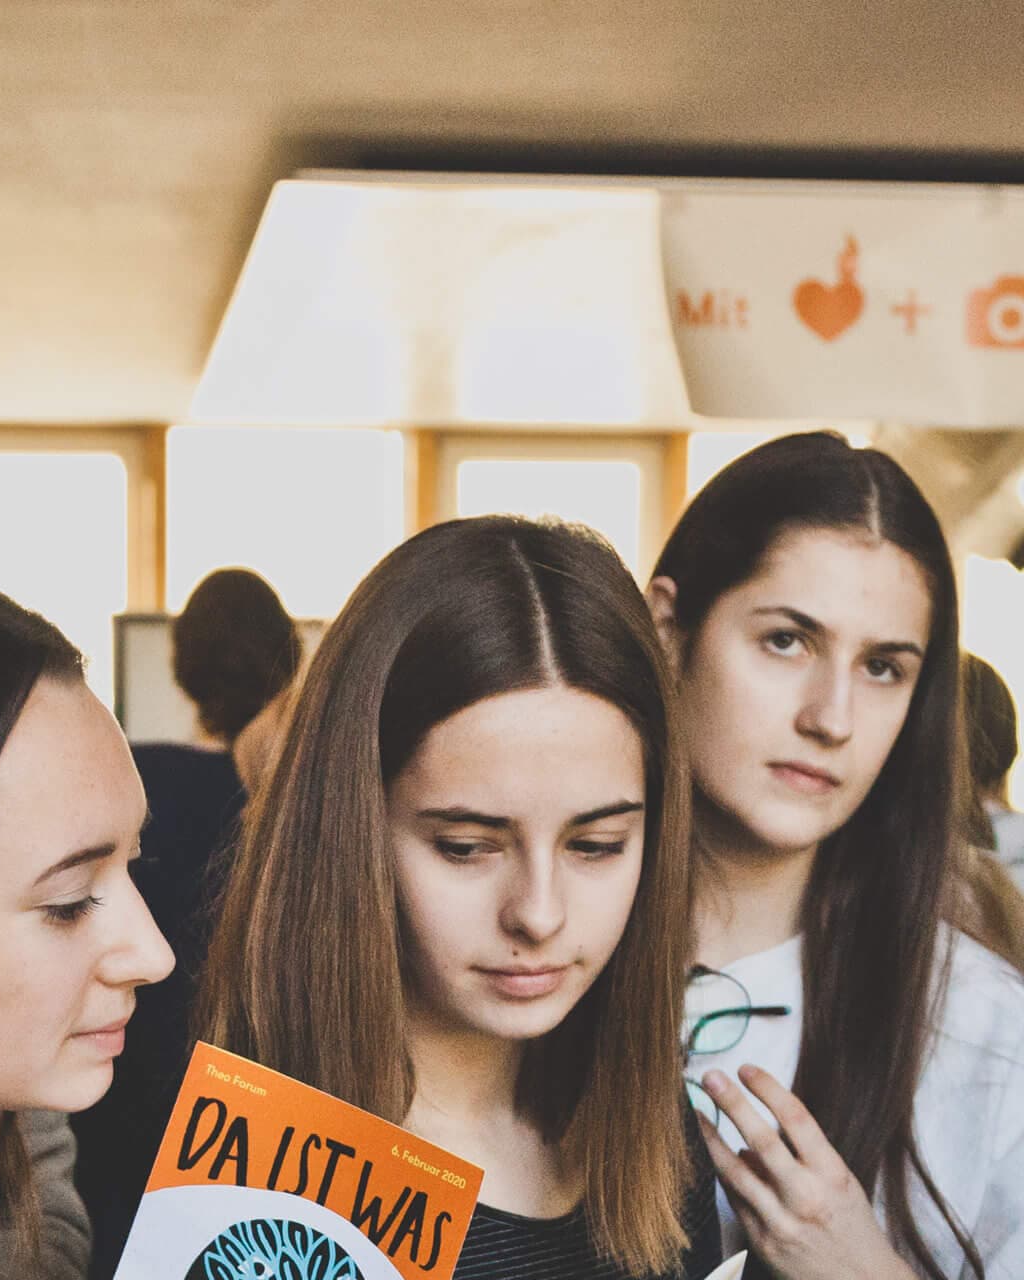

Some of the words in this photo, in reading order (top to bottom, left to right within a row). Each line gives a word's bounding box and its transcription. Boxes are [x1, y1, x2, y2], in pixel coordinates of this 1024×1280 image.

[678, 290, 748, 327] Mit
[206, 1063, 231, 1083] Theo
[232, 1075, 267, 1097] Forum
[177, 1096, 249, 1187] DA
[266, 1126, 356, 1207] IST
[350, 1160, 453, 1272] WAS
[401, 1150, 441, 1177] Februar
[441, 1169, 467, 1190] 2020
